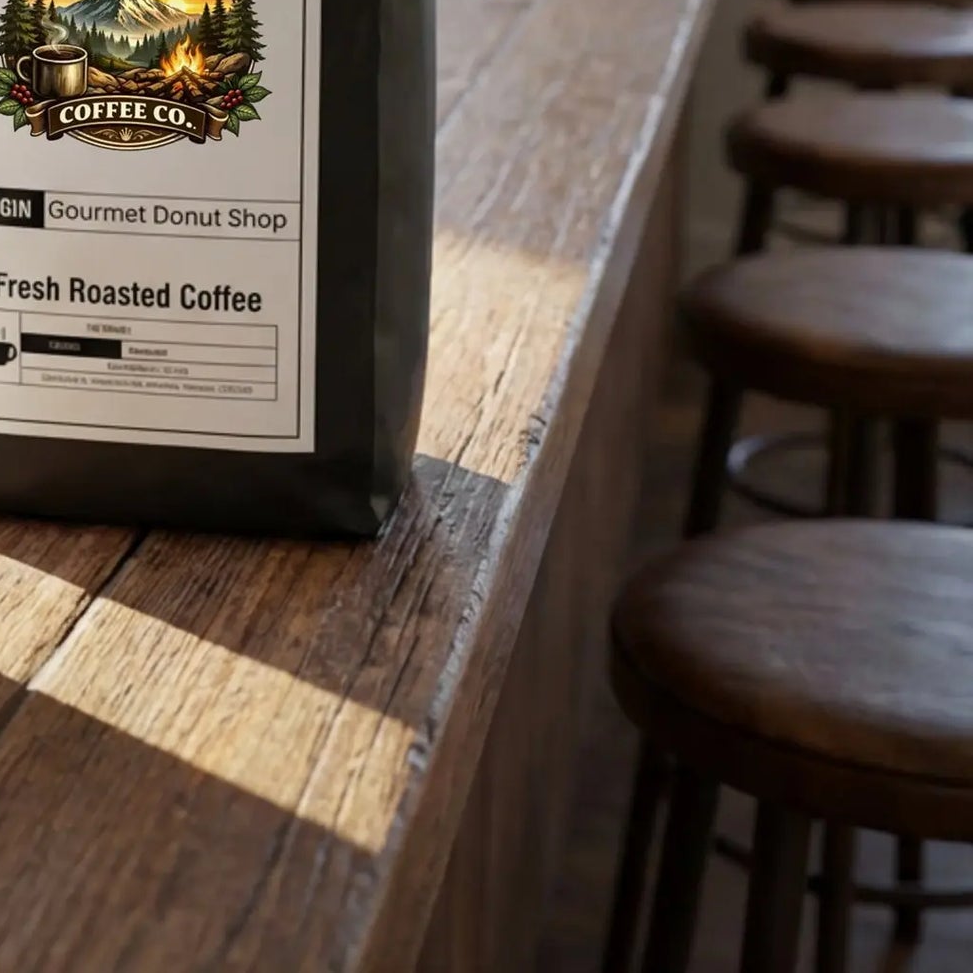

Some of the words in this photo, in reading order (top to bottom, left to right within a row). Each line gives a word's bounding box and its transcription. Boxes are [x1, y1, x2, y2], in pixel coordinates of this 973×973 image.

[59, 102, 147, 124] COFFEE
[48, 200, 147, 224] Gourmet
[153, 208, 221, 228] Donut
[227, 208, 287, 233] Shop
[69, 277, 171, 308] Roasted
[180, 283, 263, 313] Coffee
